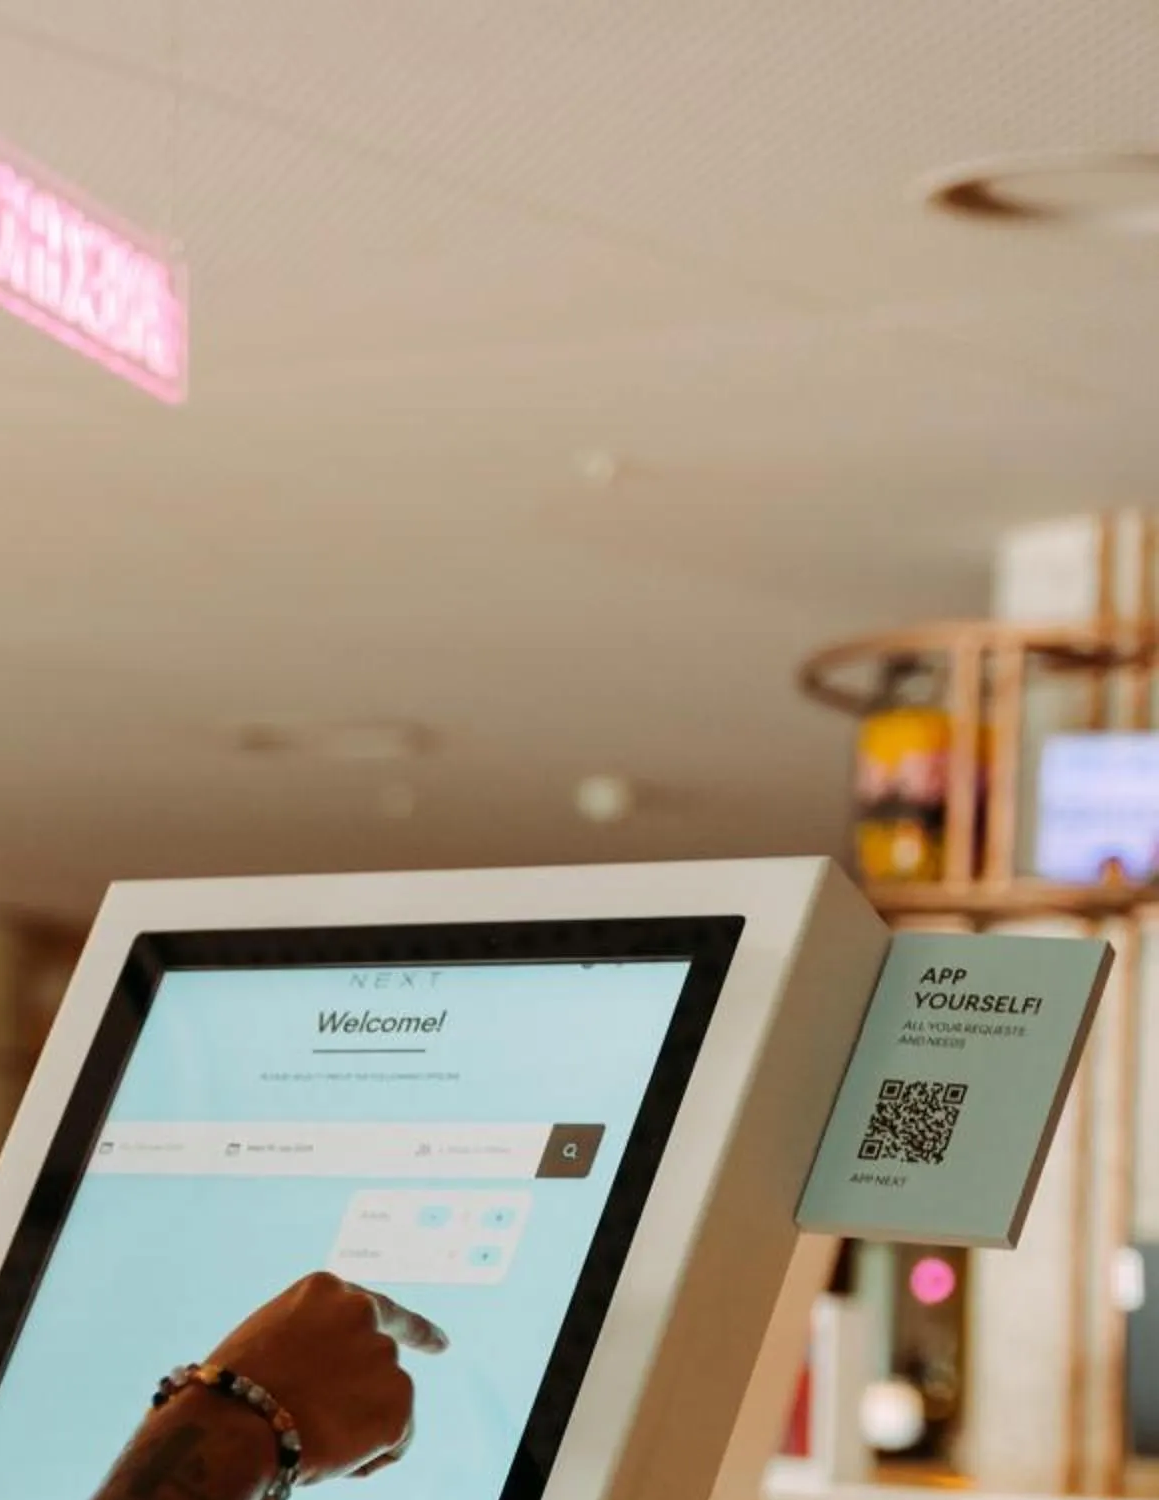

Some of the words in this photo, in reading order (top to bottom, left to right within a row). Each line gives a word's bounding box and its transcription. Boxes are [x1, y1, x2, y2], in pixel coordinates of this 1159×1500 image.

[348, 970, 443, 991] NEXT
[920, 966, 968, 985] APP
[914, 991, 1043, 1016] YOURSELF!
[317, 1009, 448, 1035] Welcome!
[902, 1019, 924, 1032] ALL
[927, 1021, 963, 1034] YOUR
[897, 1035, 926, 1047] AND
[927, 1036, 967, 1050] NEEDS
[849, 1172, 873, 1186] APP
[875, 1175, 907, 1188] NEXT
